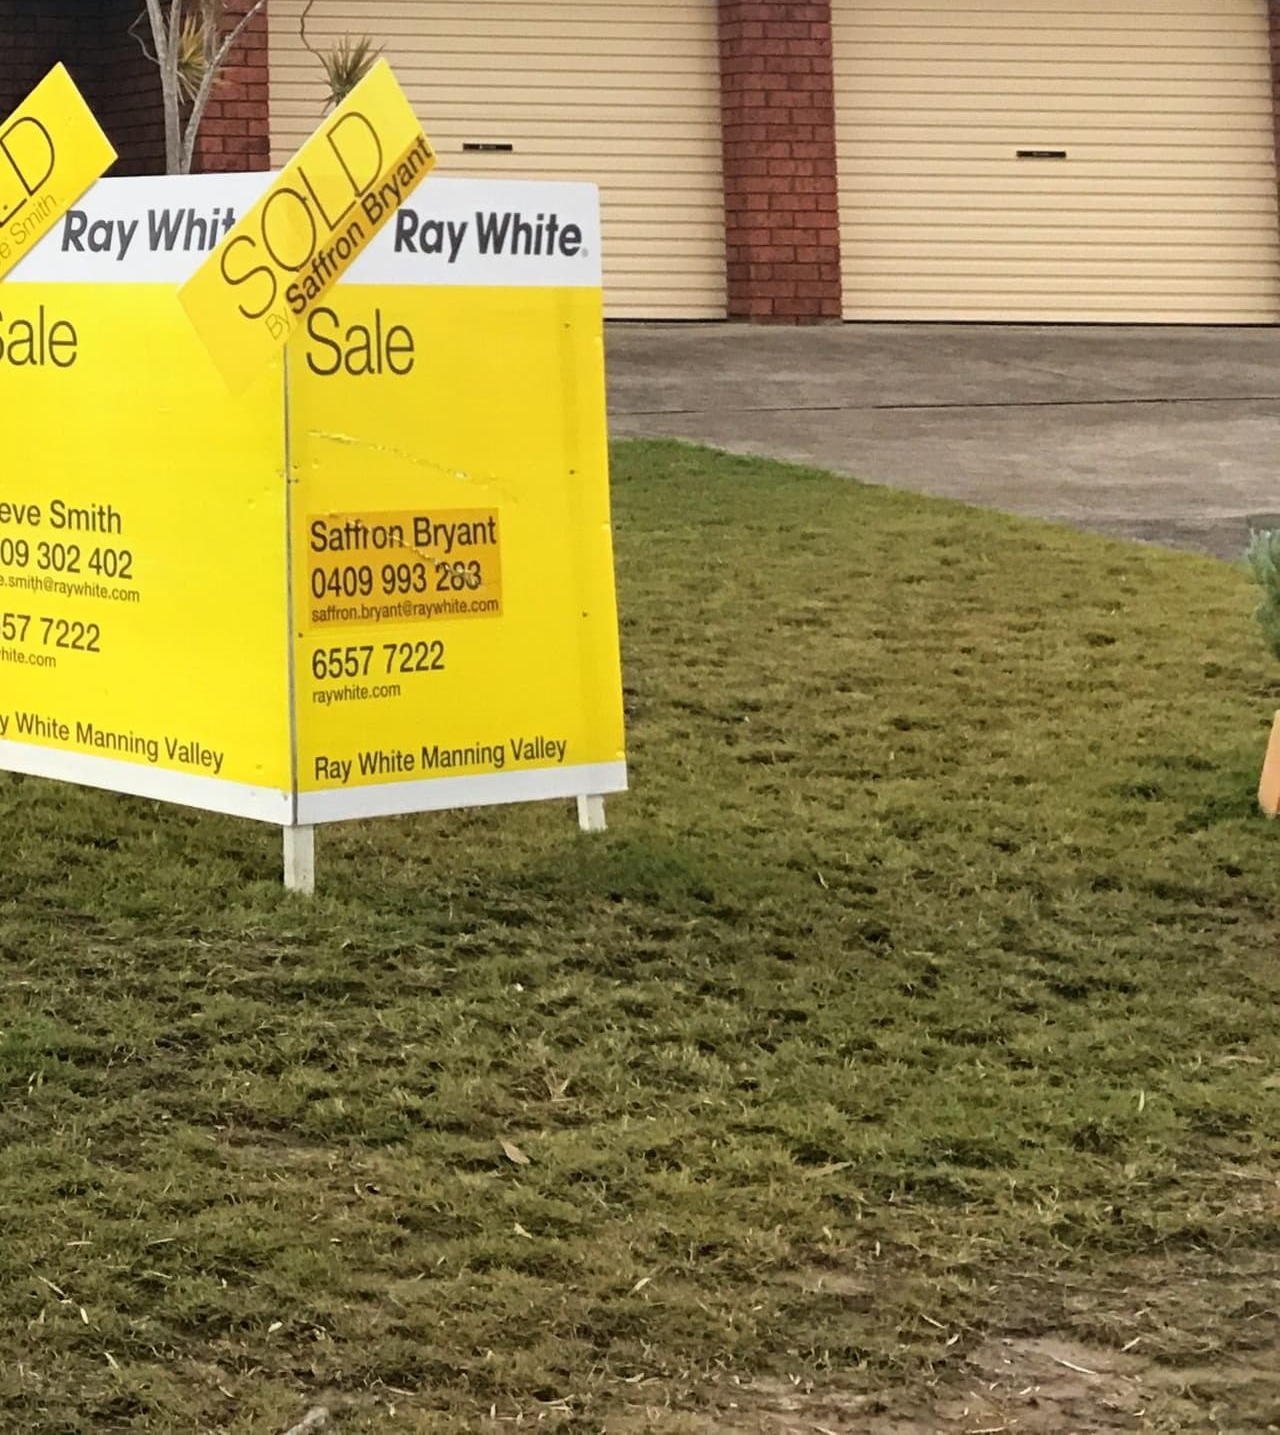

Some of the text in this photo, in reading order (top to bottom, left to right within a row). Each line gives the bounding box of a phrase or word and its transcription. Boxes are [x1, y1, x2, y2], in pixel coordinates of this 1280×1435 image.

[9, 190, 59, 245] Smith
[61, 206, 237, 262] Ray Whit
[220, 111, 384, 320] SOLD
[264, 132, 433, 341] By Saffron Bryant
[393, 208, 470, 264] Ray
[306, 306, 416, 377] Sale
[49, 499, 122, 535] Smith
[310, 515, 497, 555] Saffron Bryant
[36, 541, 81, 574] 302
[88, 546, 133, 580] 402
[311, 559, 482, 599] 0409 993 283
[311, 596, 500, 623] saffron.bryant@raywhite.com
[40, 617, 101, 653] 7222
[312, 639, 445, 680] 6557 7222
[312, 682, 401, 707] raywhite.com
[15, 711, 70, 741] White
[76, 721, 160, 763] Manning
[164, 736, 225, 774] Valley
[314, 736, 567, 784] Ray White Manning Valley
